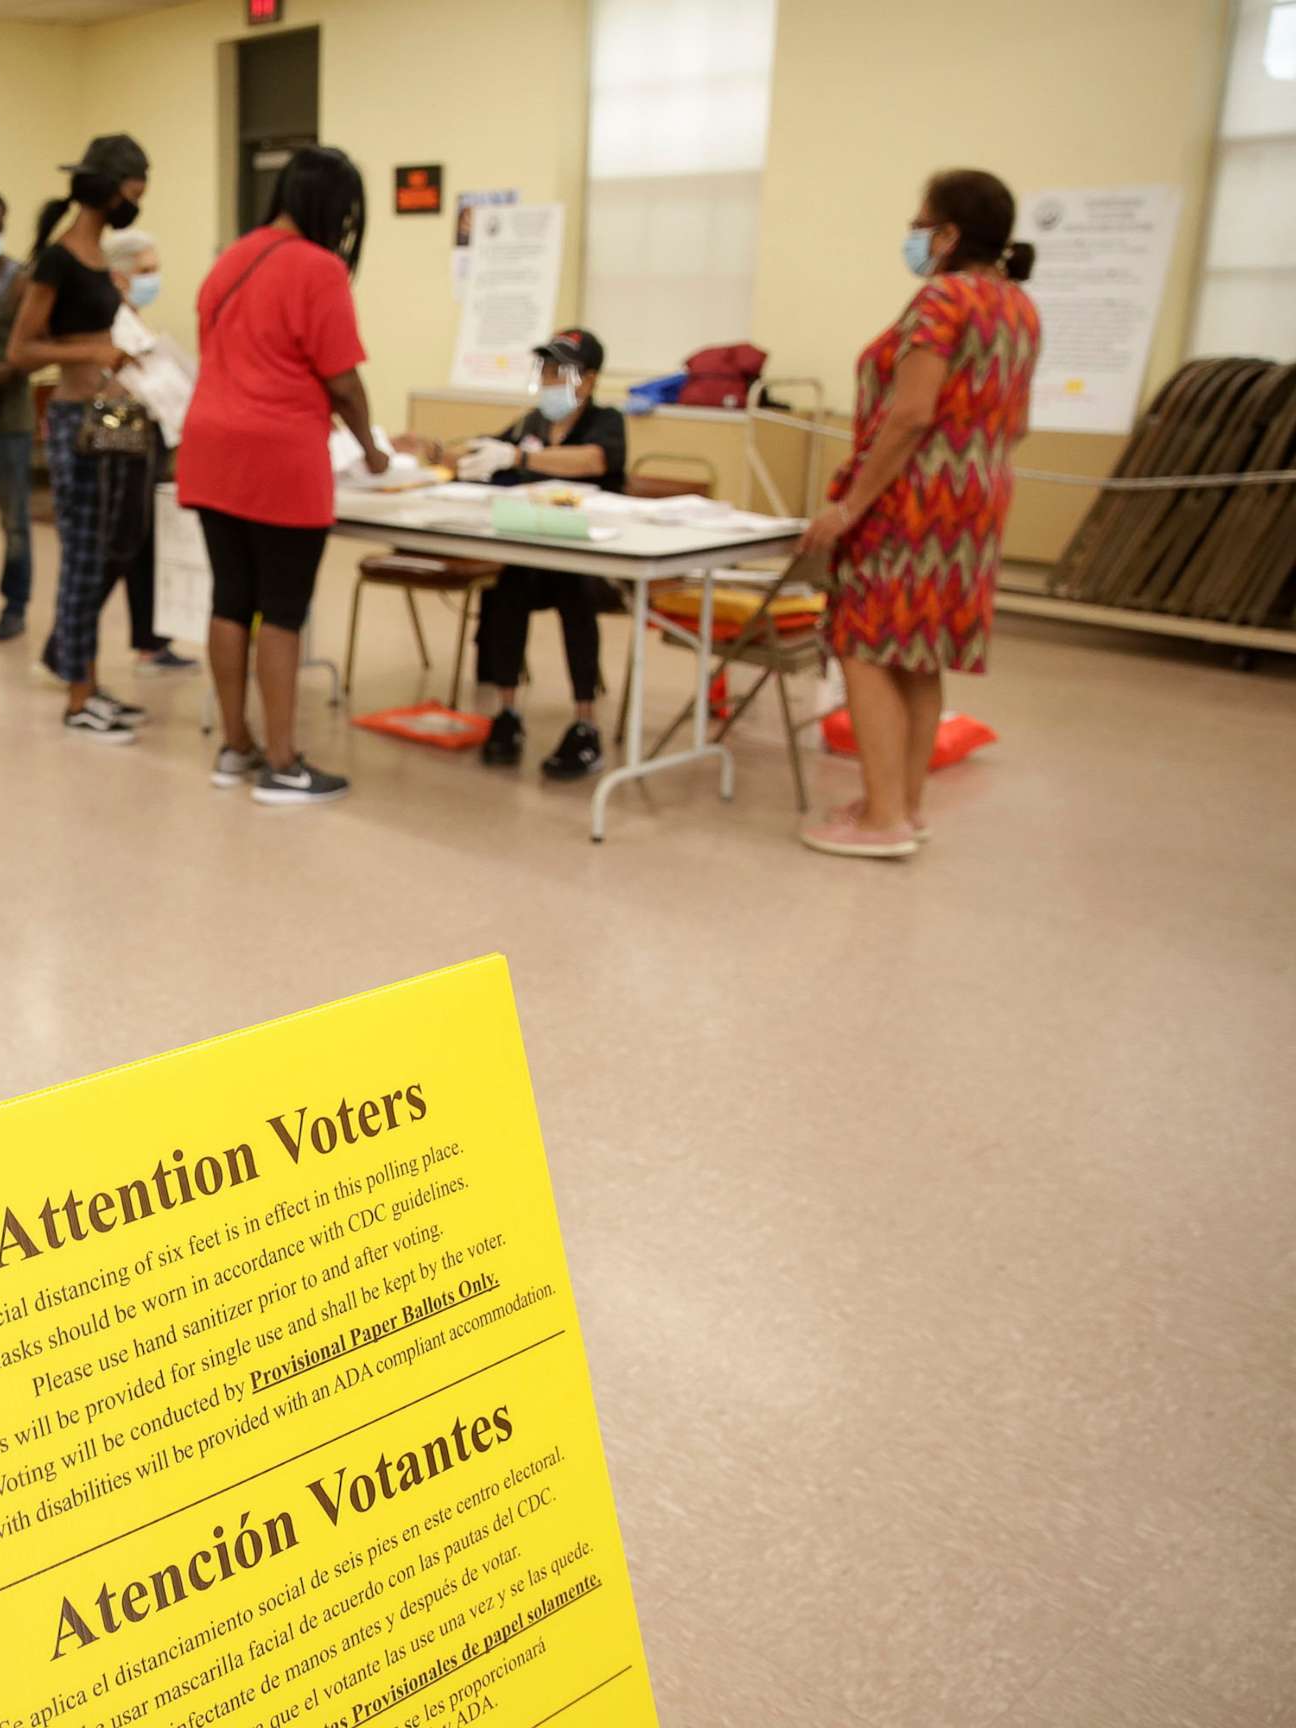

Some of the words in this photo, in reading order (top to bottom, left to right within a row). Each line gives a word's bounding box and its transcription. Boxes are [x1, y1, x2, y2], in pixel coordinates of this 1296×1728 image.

[264, 1082, 427, 1165] Voters
[31, 1362, 93, 1398] Please
[97, 1348, 129, 1372] use
[132, 1323, 178, 1358] hand
[181, 1298, 253, 1339] sanitizer
[257, 1280, 297, 1314] prior
[300, 1273, 317, 1290] to
[321, 1254, 350, 1283] and
[353, 1243, 388, 1269] after
[392, 1224, 443, 1252] voting.
[33, 1265, 131, 1312] distancing
[133, 1250, 153, 1275] of
[157, 1243, 184, 1267] six
[187, 1229, 222, 1256] feet
[224, 1222, 240, 1242] is
[242, 1215, 261, 1235] in
[264, 1195, 311, 1226] effect
[313, 1189, 330, 1208] in
[333, 1176, 362, 1201] this
[365, 1158, 420, 1194] polling
[420, 1142, 463, 1173] place.
[47, 1307, 111, 1349] should
[113, 1303, 137, 1323] be
[140, 1285, 188, 1312] worn
[190, 1274, 209, 1294] in
[213, 1239, 305, 1286] accordance
[308, 1219, 345, 1247] with
[347, 1202, 385, 1232] CDC
[390, 1176, 468, 1221] guidelines.
[13, 1414, 52, 1445] will
[55, 1409, 80, 1429] be
[83, 1368, 166, 1424] provided
[170, 1360, 196, 1384] for
[200, 1337, 251, 1372] single
[254, 1326, 283, 1348] use
[287, 1306, 317, 1336] and
[320, 1289, 358, 1322] shall
[359, 1285, 380, 1304] be
[381, 1268, 417, 1295] kept
[417, 1260, 437, 1281] by
[440, 1250, 463, 1270] the
[466, 1233, 506, 1258] voter.
[35, 1470, 132, 1522] disabilities
[134, 1448, 169, 1479] will
[171, 1444, 194, 1463] be
[196, 1404, 270, 1459] provided
[272, 1390, 308, 1419] with
[310, 1384, 330, 1403] an
[333, 1361, 374, 1394] ADA
[375, 1329, 446, 1374] compliant
[448, 1283, 556, 1341] accommodation.
[59, 1437, 98, 1469] will
[100, 1432, 125, 1452] be
[129, 1386, 220, 1441] conducted
[222, 1380, 244, 1403] by
[248, 1333, 347, 1391] Provisional
[349, 1314, 398, 1347] Paper
[400, 1290, 455, 1324] Ballots
[457, 1272, 499, 1299] Only.
[29, 1689, 88, 1727] aplica
[91, 1672, 109, 1697] el
[114, 1608, 254, 1686] distanciamiento
[257, 1575, 306, 1616] social
[309, 1568, 329, 1589] de
[333, 1550, 364, 1578] seis
[366, 1534, 399, 1566] pies
[401, 1523, 420, 1542] en
[423, 1506, 452, 1531] este
[455, 1482, 500, 1514] centro
[502, 1445, 565, 1489] electoral.
[49, 1510, 300, 1662] Atención
[304, 1404, 513, 1527] Votantes
[109, 1699, 149, 1727] usar
[153, 1651, 244, 1709] mascarilla
[247, 1621, 295, 1661] facial
[298, 1613, 318, 1634] de
[321, 1579, 384, 1623] acuerdo
[387, 1564, 416, 1588] con
[417, 1550, 440, 1572] las
[443, 1524, 490, 1564] pautas
[492, 1506, 514, 1532] del
[516, 1486, 556, 1518] CDC.
[260, 1672, 280, 1695] de
[284, 1643, 338, 1682] manos
[340, 1619, 382, 1652] antes
[384, 1612, 394, 1633] y
[399, 1577, 458, 1620] después
[460, 1566, 478, 1586] de
[481, 1545, 521, 1574] votar.
[269, 1703, 300, 1727] que
[303, 1687, 319, 1711] el
[322, 1659, 381, 1699] votante
[383, 1644, 407, 1667] las
[409, 1629, 435, 1653] use
[438, 1612, 466, 1637] una
[468, 1596, 494, 1618] vez
[496, 1589, 505, 1609] y
[509, 1579, 525, 1597] se
[526, 1565, 548, 1586] las
[550, 1541, 593, 1576] quede.
[350, 1654, 458, 1724] Provisionales
[460, 1641, 480, 1661] de
[482, 1611, 524, 1654] papel
[526, 1573, 601, 1624] solamente.
[403, 1713, 421, 1728] se
[423, 1699, 446, 1722] les
[448, 1635, 547, 1711] proporcionará
[456, 1694, 498, 1727] ADA.
